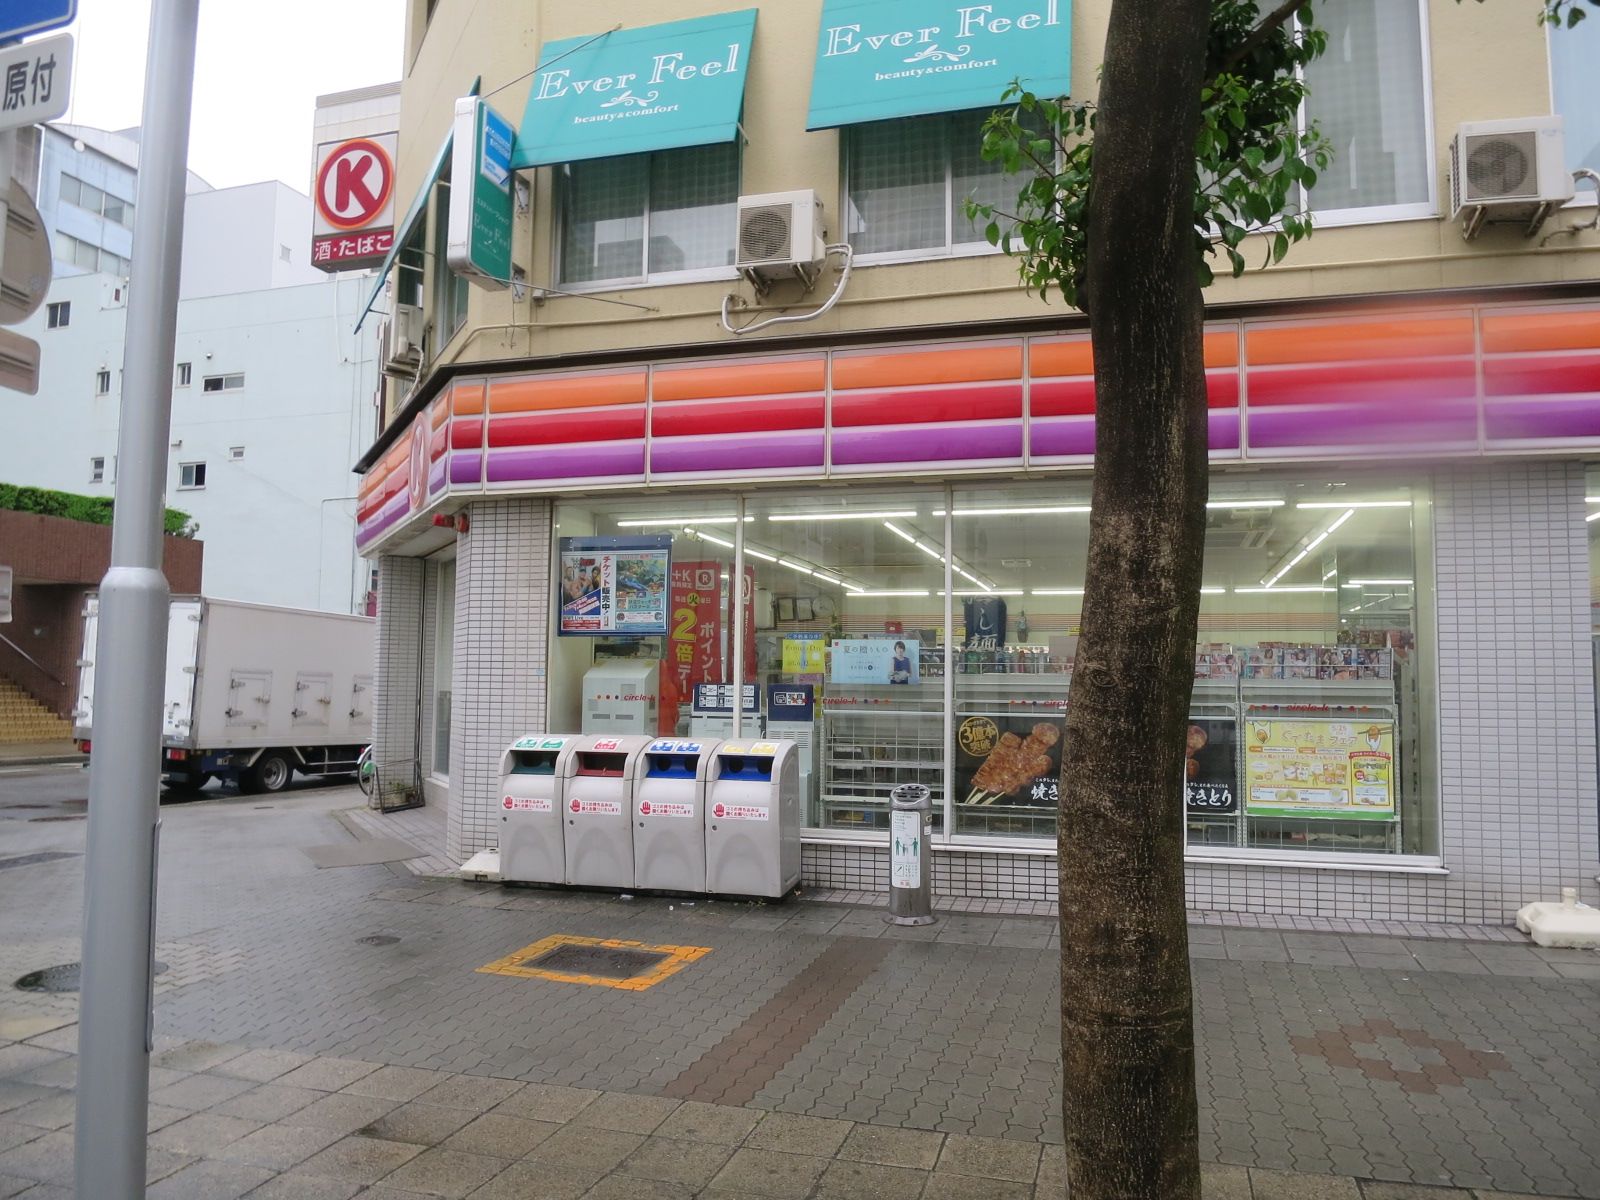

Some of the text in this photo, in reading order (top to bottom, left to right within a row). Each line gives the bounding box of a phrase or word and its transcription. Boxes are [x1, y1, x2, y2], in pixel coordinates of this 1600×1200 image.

[824, 0, 1060, 57] Ever Feel
[3, 53, 56, 111] 原付
[535, 43, 739, 101] Ever Feel
[874, 58, 998, 81] beauty&comfort
[573, 103, 680, 125] beauty&comfort
[335, 154, 379, 214] K
[700, 621, 715, 683] ポイント
